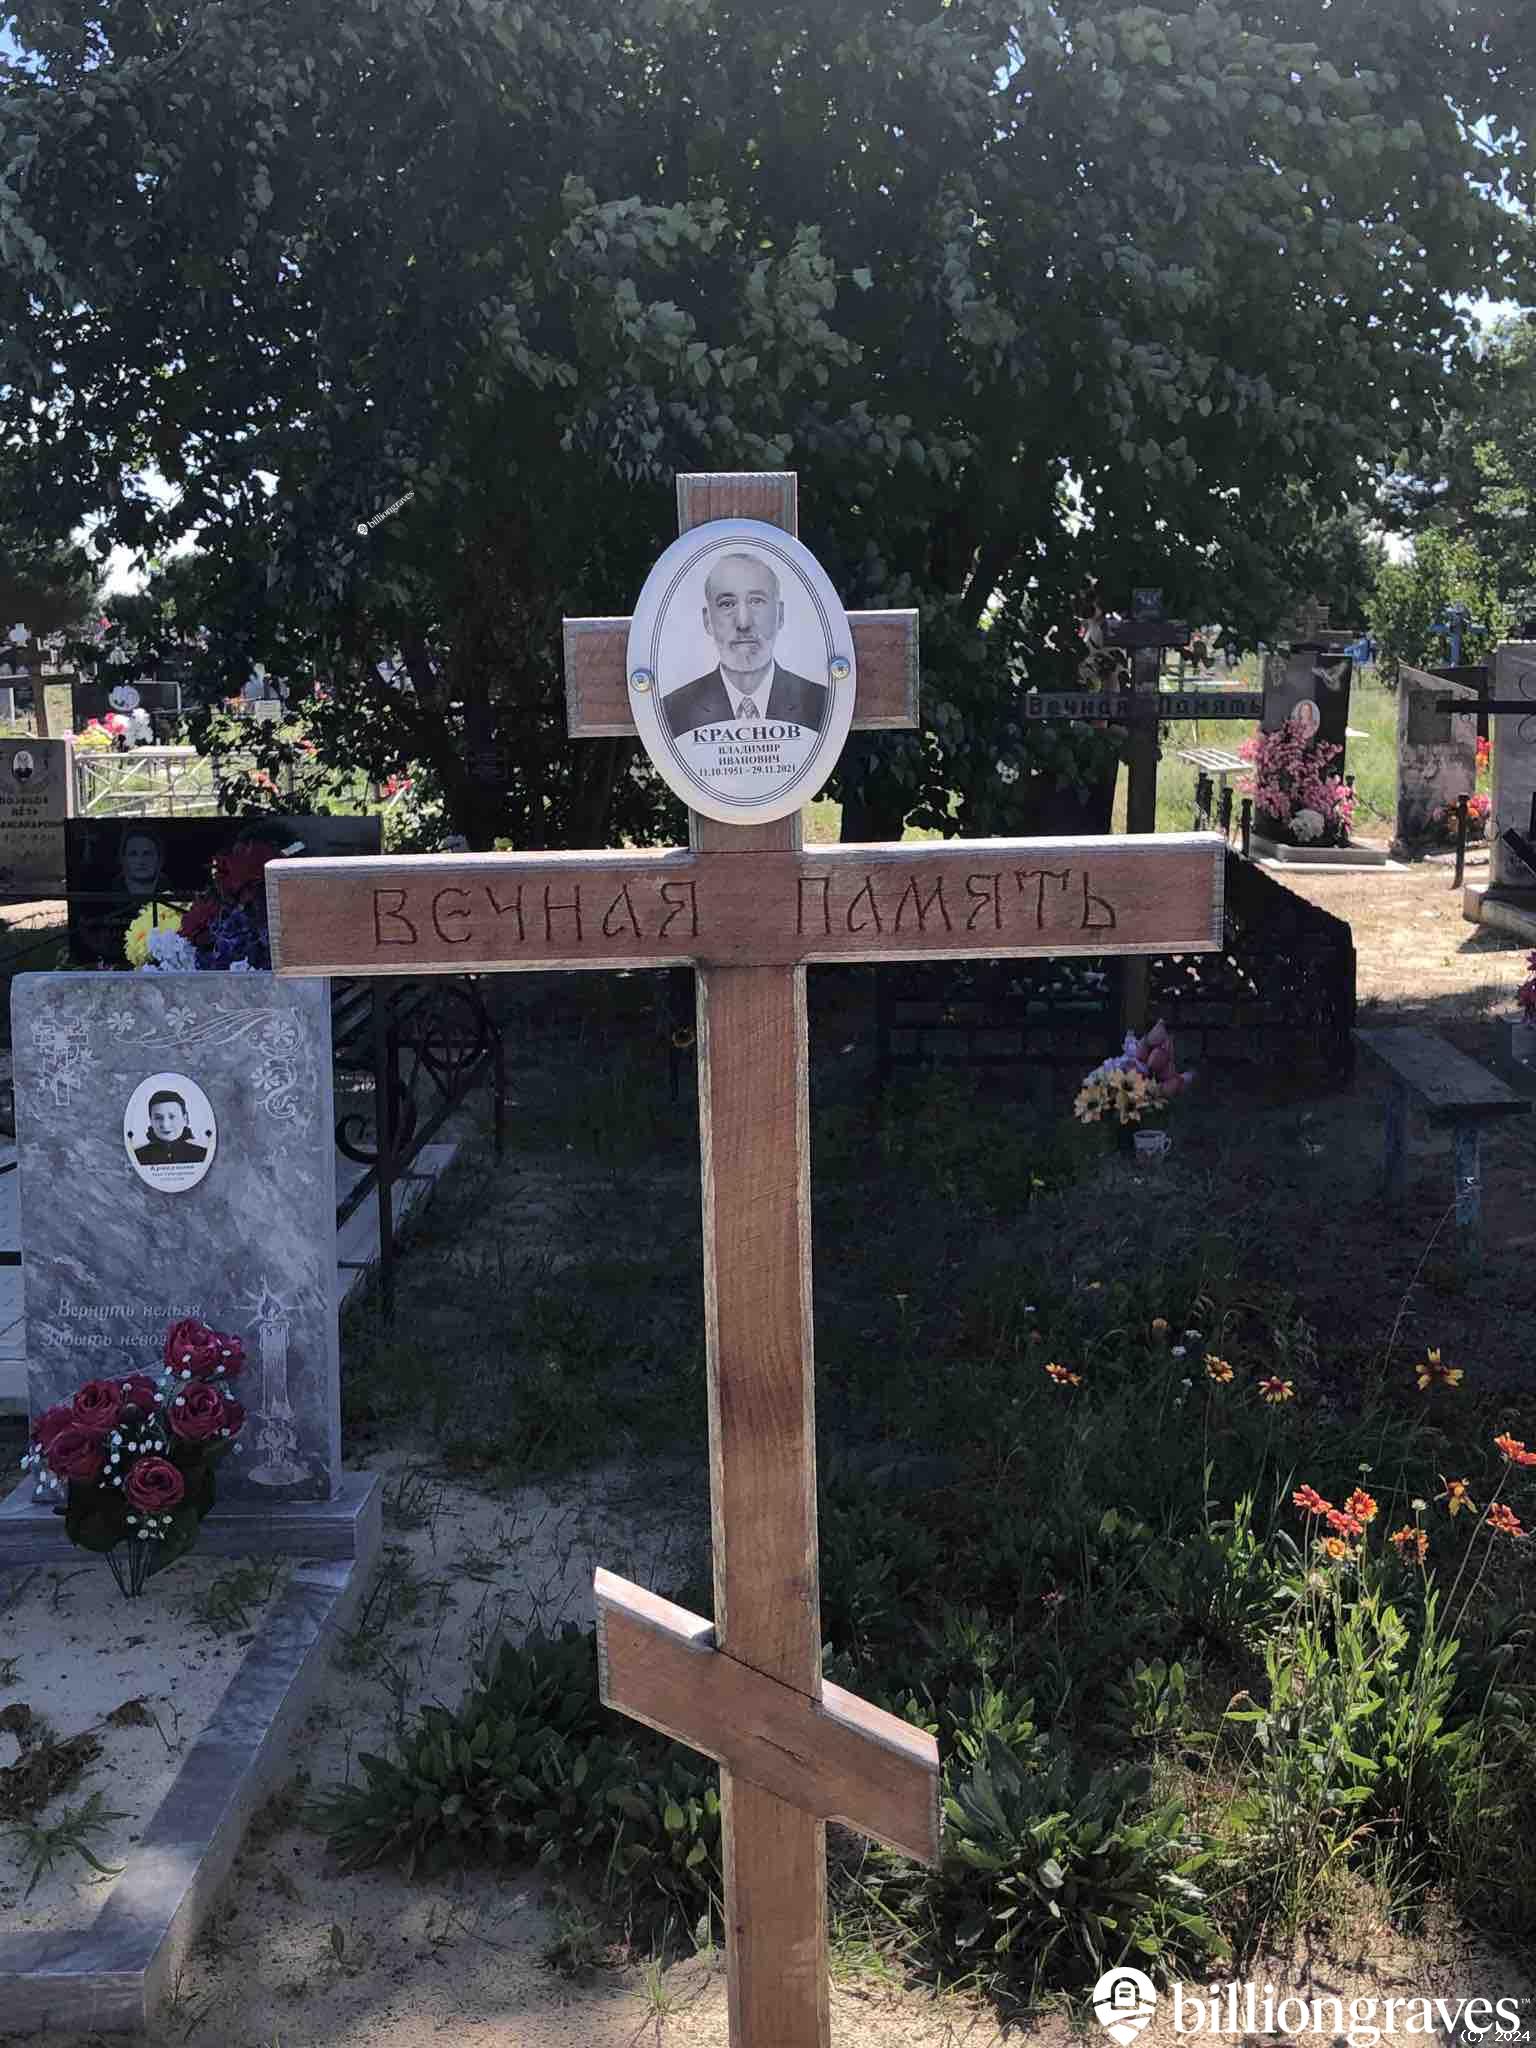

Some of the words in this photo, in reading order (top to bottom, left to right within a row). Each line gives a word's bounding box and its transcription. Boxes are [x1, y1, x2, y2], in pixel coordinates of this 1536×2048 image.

[693, 725, 800, 743] КРАСНОВ
[719, 744, 780, 755] ВЛАДИМИР
[719, 754, 780, 766] ИВАНОВИЧ
[699, 767, 743, 777] 11.10.1951
[373, 880, 699, 945] ВЕЧНАЯ
[797, 869, 1117, 935] ПАМЯТЬ
[56, 1298, 135, 1320] Вернуть
[120, 1334, 168, 1347] невоз
